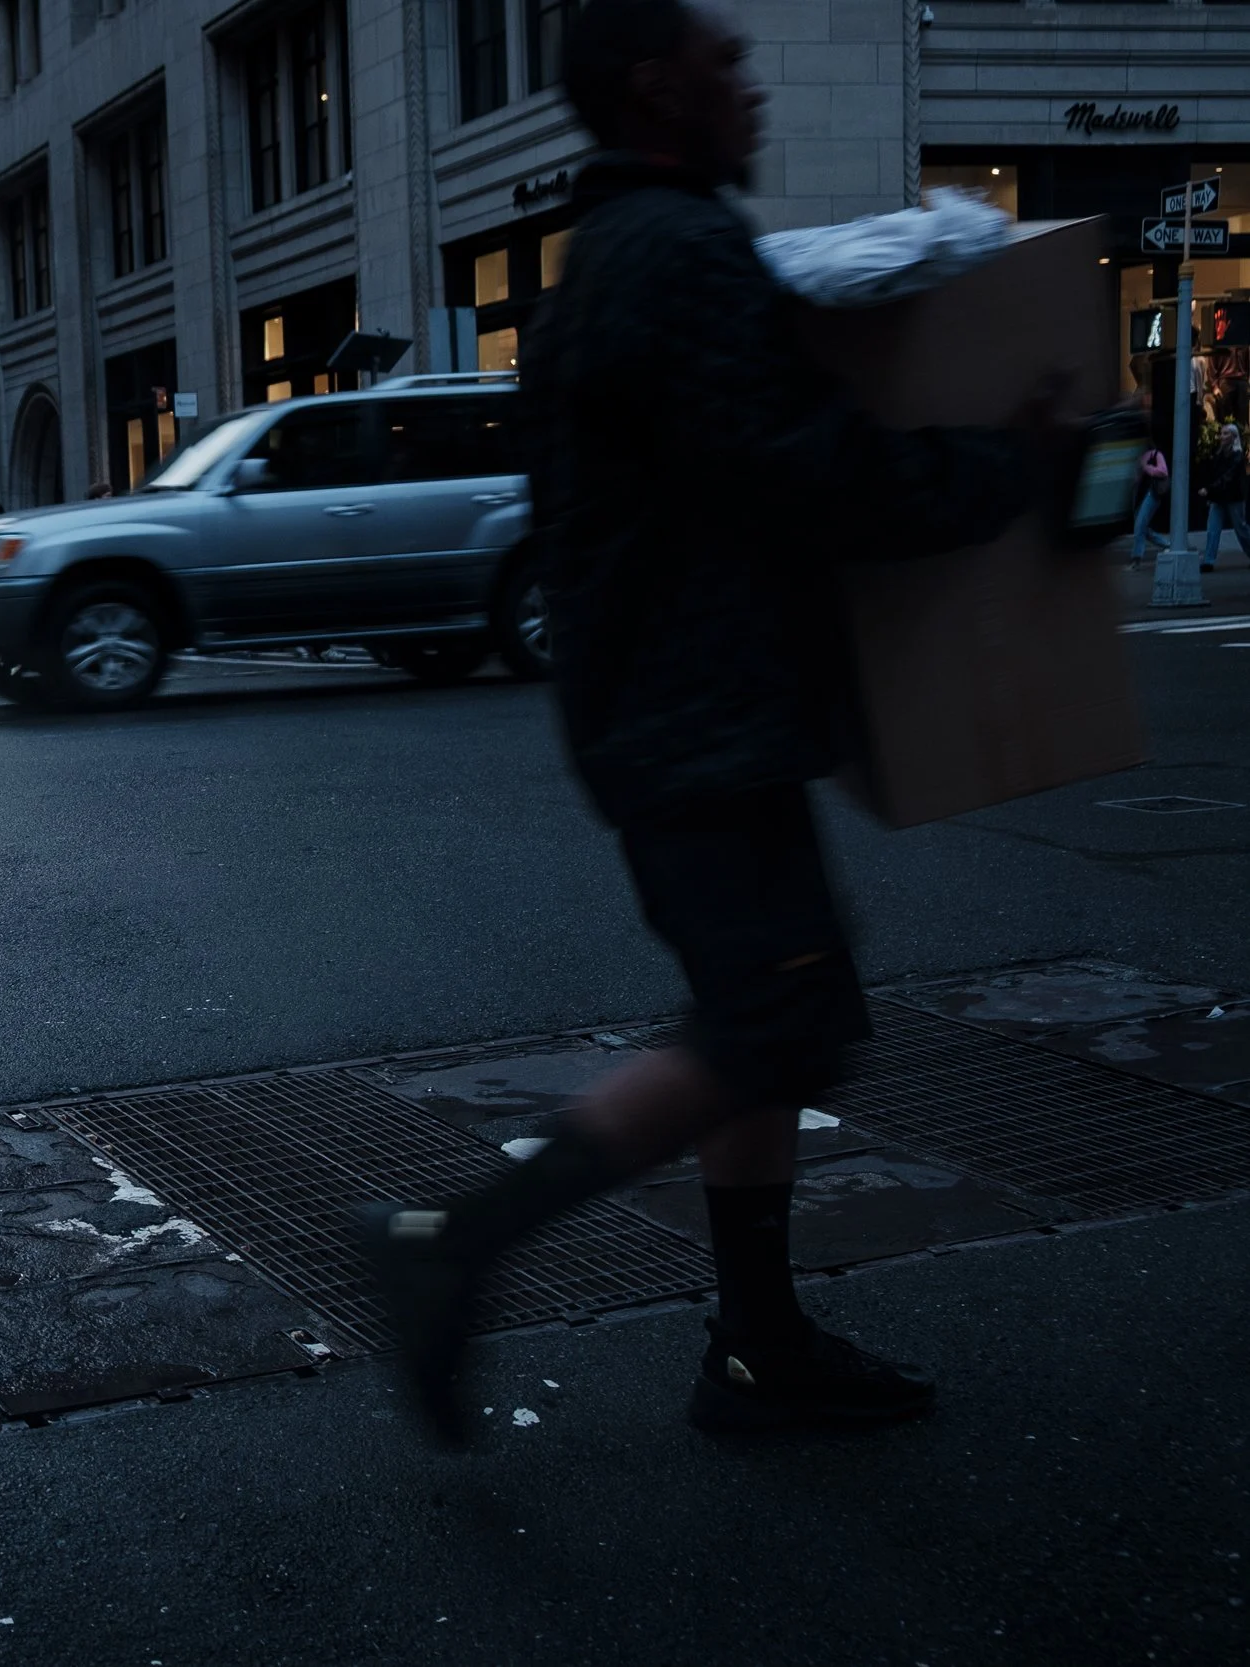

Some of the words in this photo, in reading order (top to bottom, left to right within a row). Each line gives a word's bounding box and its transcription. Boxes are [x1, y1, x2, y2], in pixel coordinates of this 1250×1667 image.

[1064, 102, 1180, 136] Madewell
[1170, 196, 1186, 211] ONE
[1195, 190, 1212, 207] WAY
[1154, 229, 1179, 242] ONE
[1194, 230, 1222, 242] WAY
